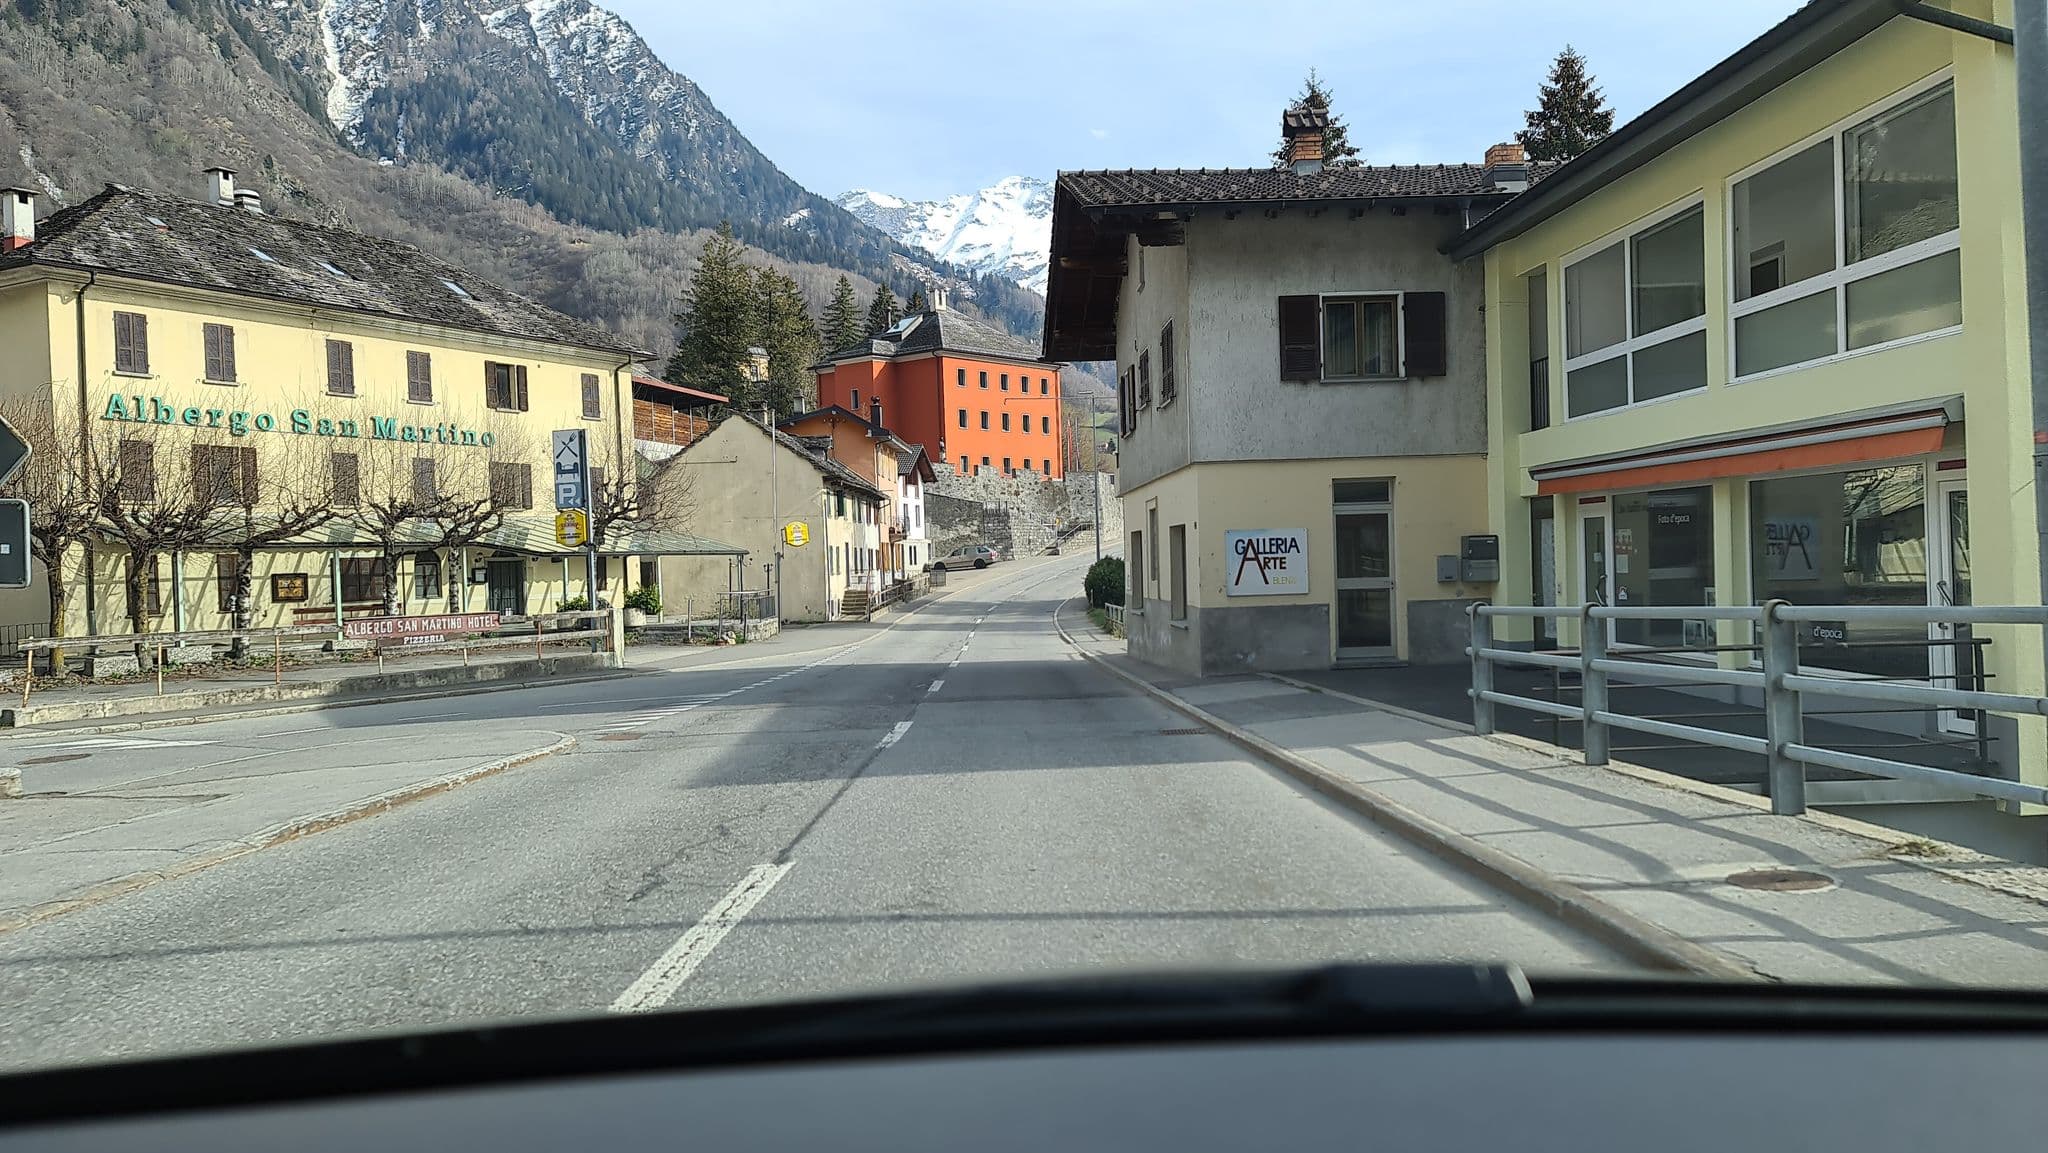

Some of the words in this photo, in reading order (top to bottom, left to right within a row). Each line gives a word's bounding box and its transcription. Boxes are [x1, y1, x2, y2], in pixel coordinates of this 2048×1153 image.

[101, 393, 275, 437] Albergo
[290, 408, 360, 438] San
[370, 415, 496, 448] Martino
[558, 483, 577, 505] P
[1234, 537, 1301, 555] GALLERIA
[345, 620, 393, 636] ALBERGO
[397, 618, 418, 633] SAN
[421, 617, 462, 632] MARTINO
[468, 614, 496, 629] HOTEL
[403, 634, 446, 645] PIZZERIA
